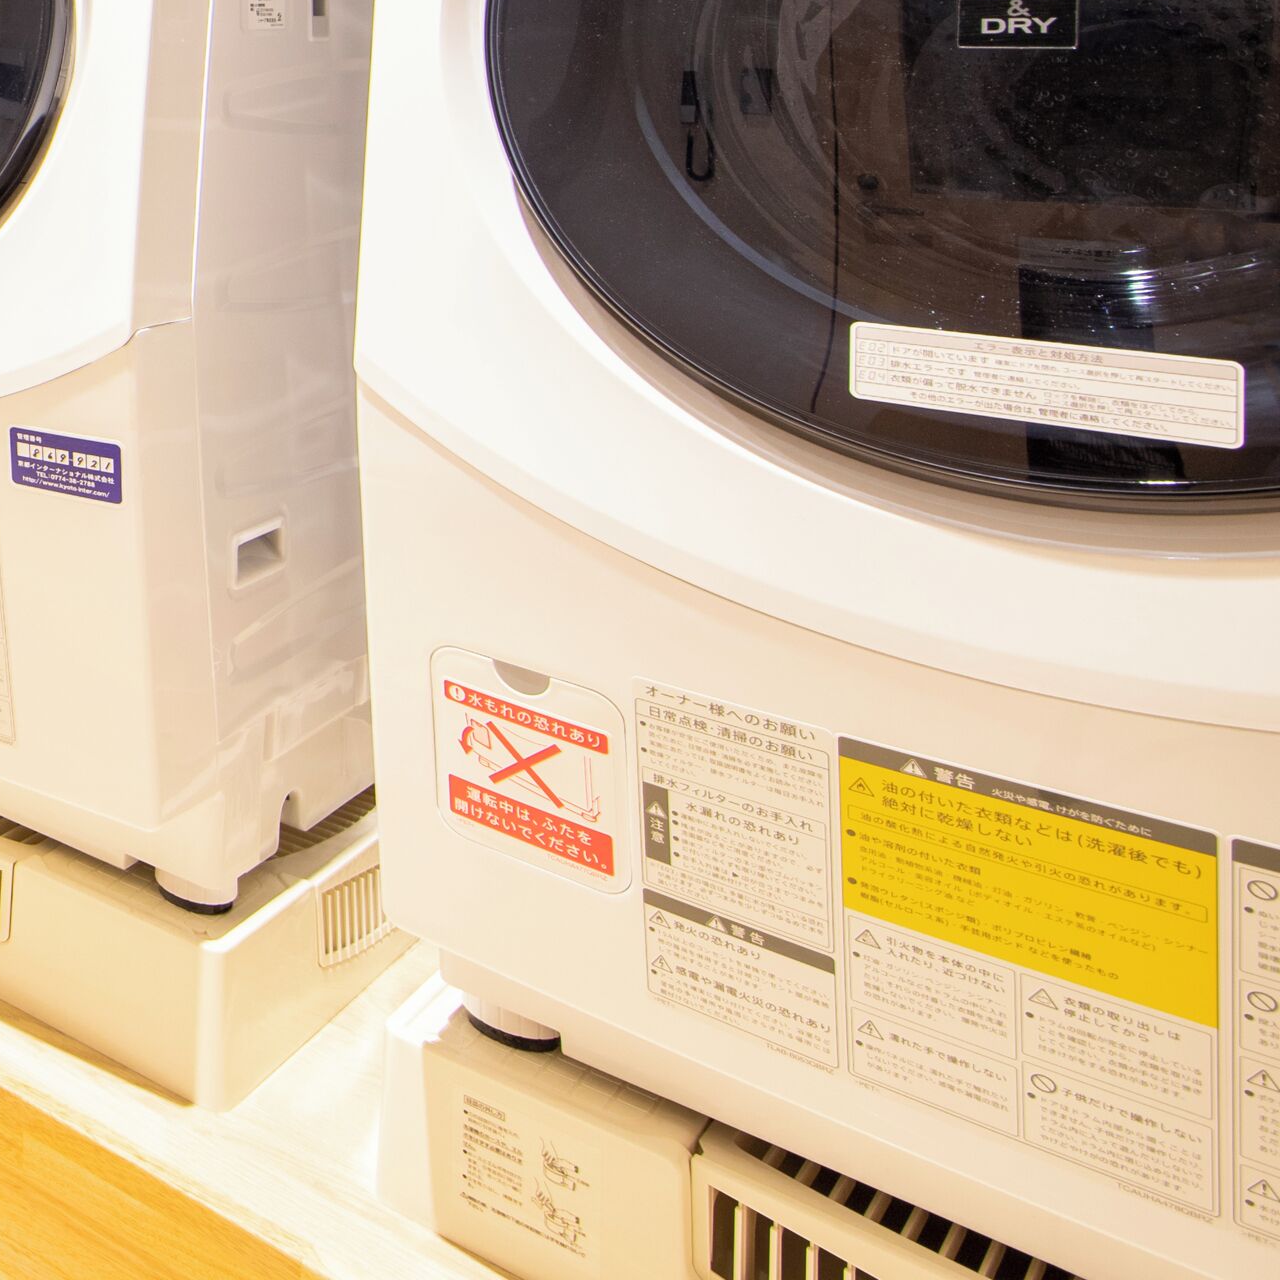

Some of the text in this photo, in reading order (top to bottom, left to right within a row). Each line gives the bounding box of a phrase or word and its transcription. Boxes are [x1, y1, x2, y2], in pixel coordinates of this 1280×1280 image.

[980, 16, 1057, 35] DRY
[468, 692, 602, 749] 水もれの恐れあり
[645, 685, 816, 741] オーナー様へのお願い
[465, 786, 593, 848] 運転中は、ふたを
[653, 773, 813, 832] 排水フィルターのお手入れ
[685, 802, 799, 845] 水漏れの恐れあり
[882, 796, 1032, 846] 絶対に乾燥しない
[933, 766, 1153, 838] 警告 火災や感電、けがを防ぐために
[454, 798, 609, 871] 開けないでください。
[674, 920, 761, 959] 発火の恐れあり
[731, 924, 765, 946] 警告
[886, 935, 1004, 983] 引火物を本体の中に
[1063, 996, 1181, 1041] 衣類の取り出しは
[1064, 1008, 1150, 1043] 停止してから
[890, 1033, 1007, 1082] 濡れた手で操作しない
[1063, 1088, 1203, 1144] 子供だけで操作しない
